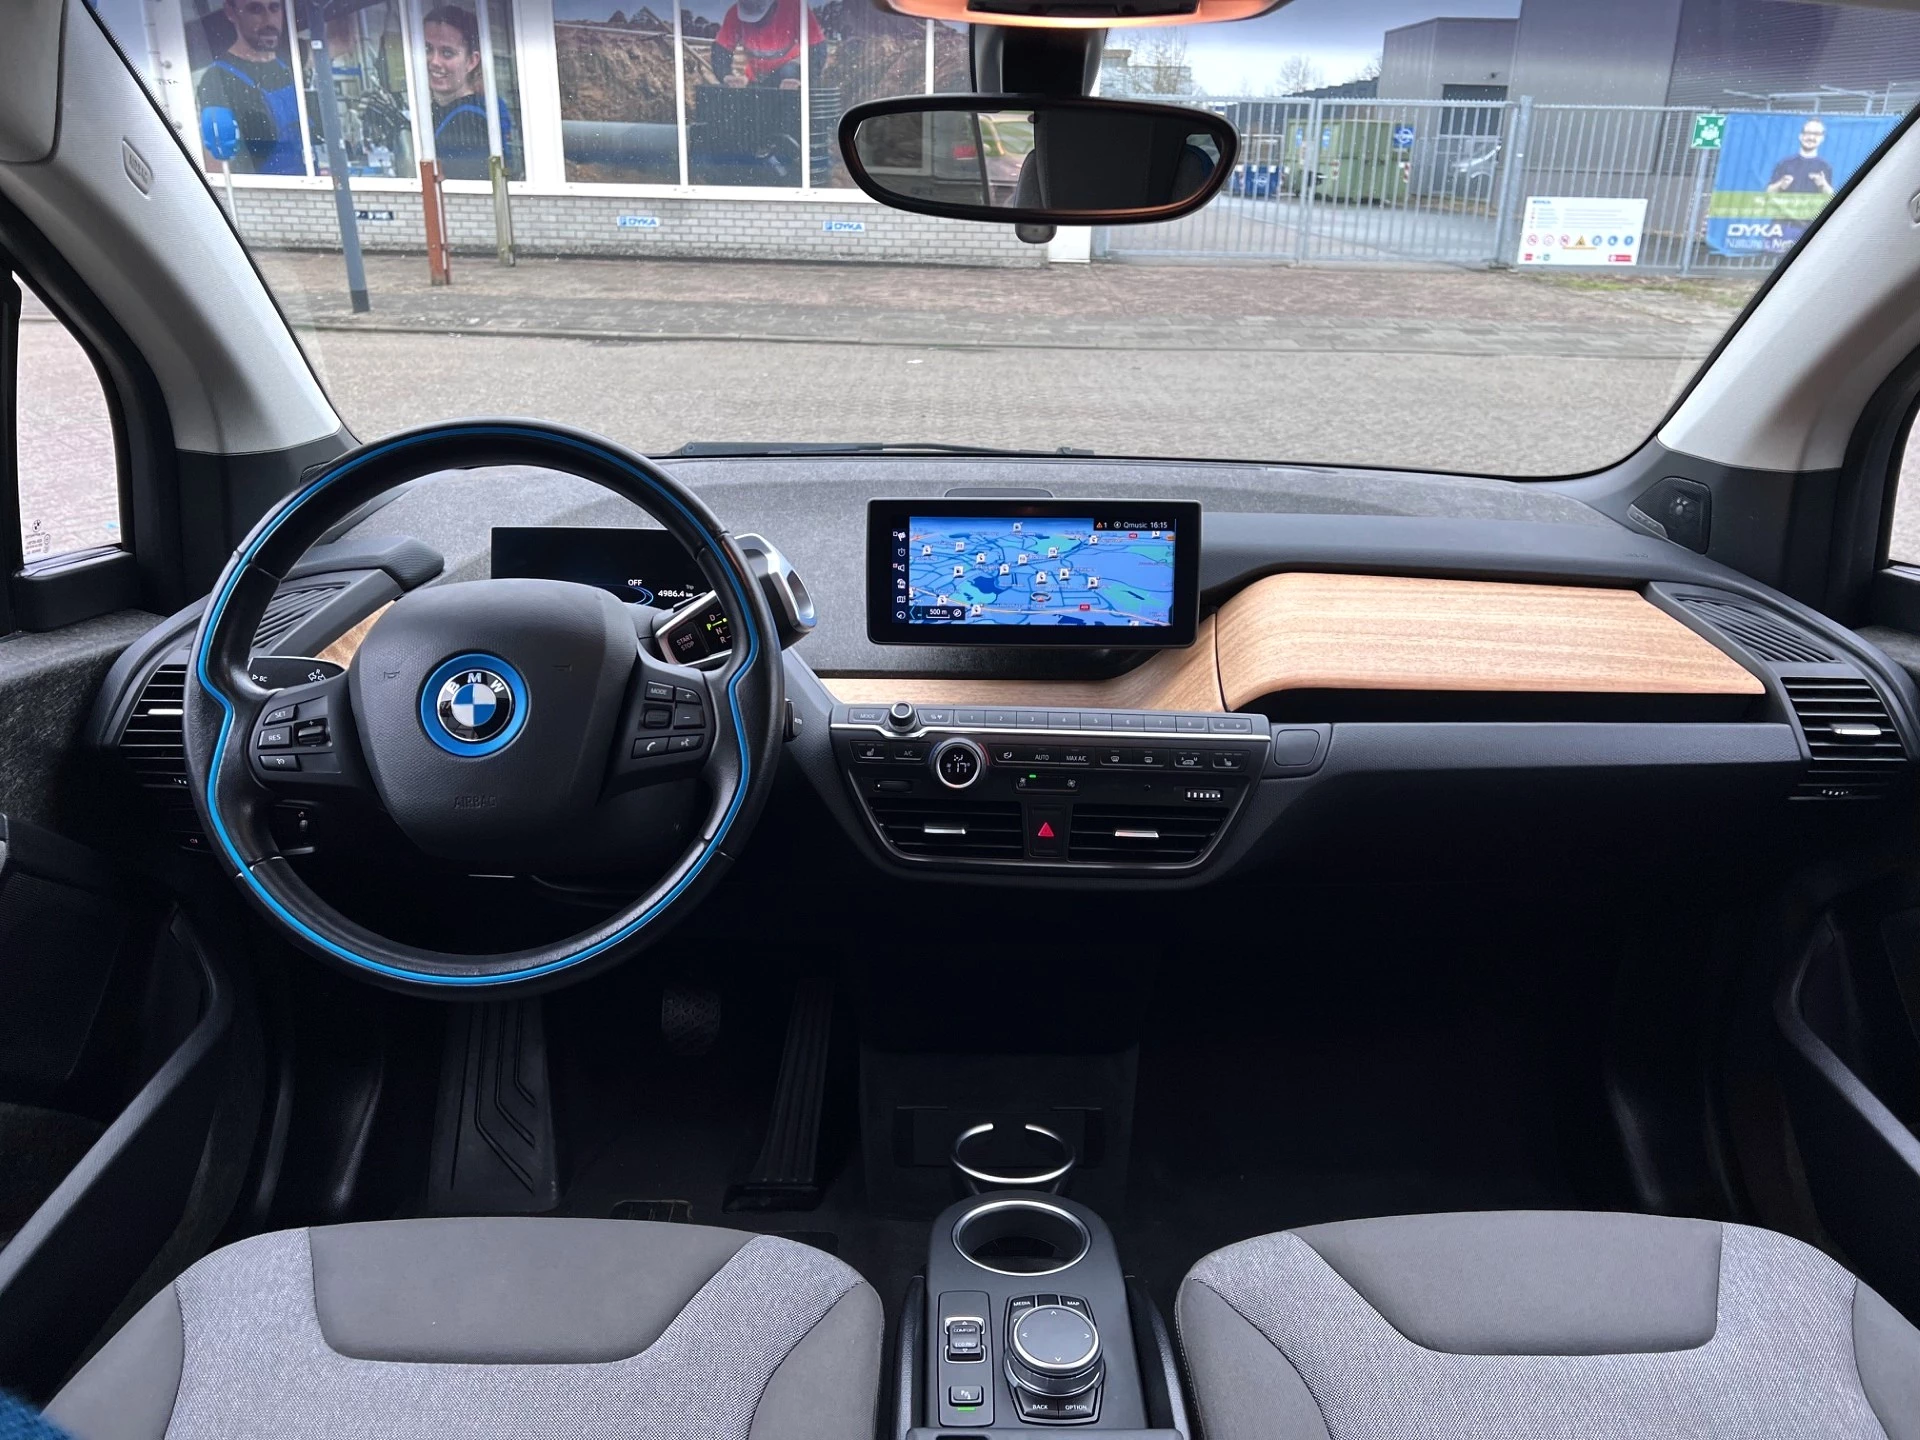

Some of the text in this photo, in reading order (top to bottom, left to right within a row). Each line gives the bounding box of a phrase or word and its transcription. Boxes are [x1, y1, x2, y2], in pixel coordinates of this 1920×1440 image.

[628, 218, 657, 227] DYKA
[833, 222, 862, 231] DYKA
[1726, 223, 1784, 237] DYKA
[706, 623, 712, 631] P
[715, 627, 722, 635] N
[676, 633, 693, 646] START
[681, 641, 695, 651] STOP
[446, 672, 505, 695] BMW
[650, 688, 667, 696] MODE
[274, 710, 286, 719] SET
[268, 733, 281, 741] RES
[453, 795, 498, 810] AIRBAG
